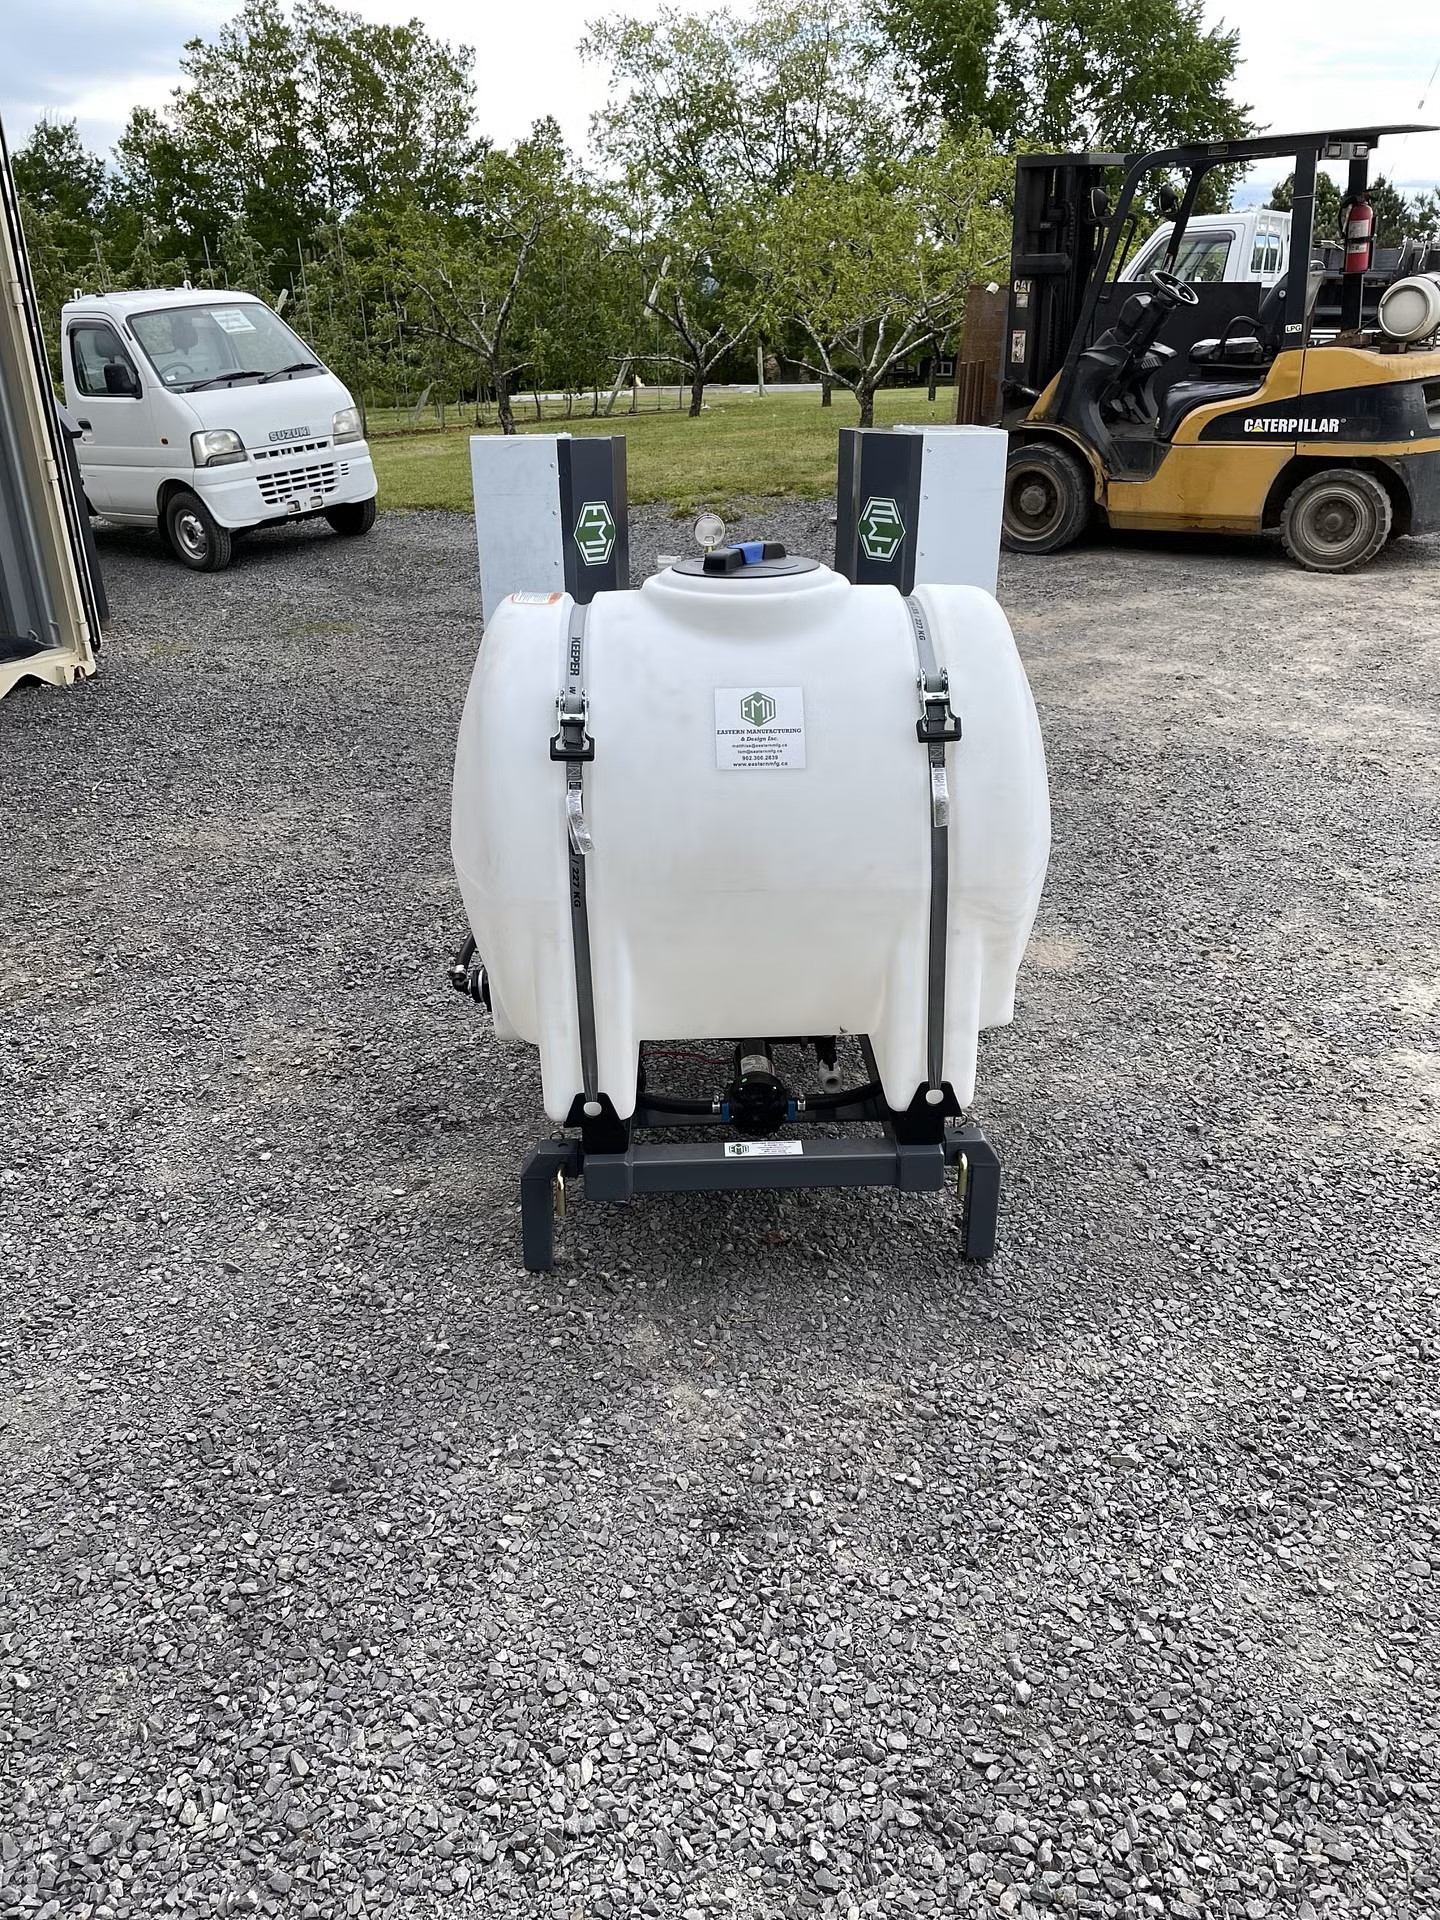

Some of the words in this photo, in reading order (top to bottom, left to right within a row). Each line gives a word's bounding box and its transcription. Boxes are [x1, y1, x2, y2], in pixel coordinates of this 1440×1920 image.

[1013, 279, 1033, 293] CAT
[1286, 324, 1302, 332] LPG
[1243, 418, 1340, 433] CATERPILLAR
[269, 426, 311, 442] SUZUKI
[917, 630, 926, 641] KG
[570, 636, 581, 676] KEEPER
[572, 867, 580, 889] 227
[573, 891, 582, 908] KG
